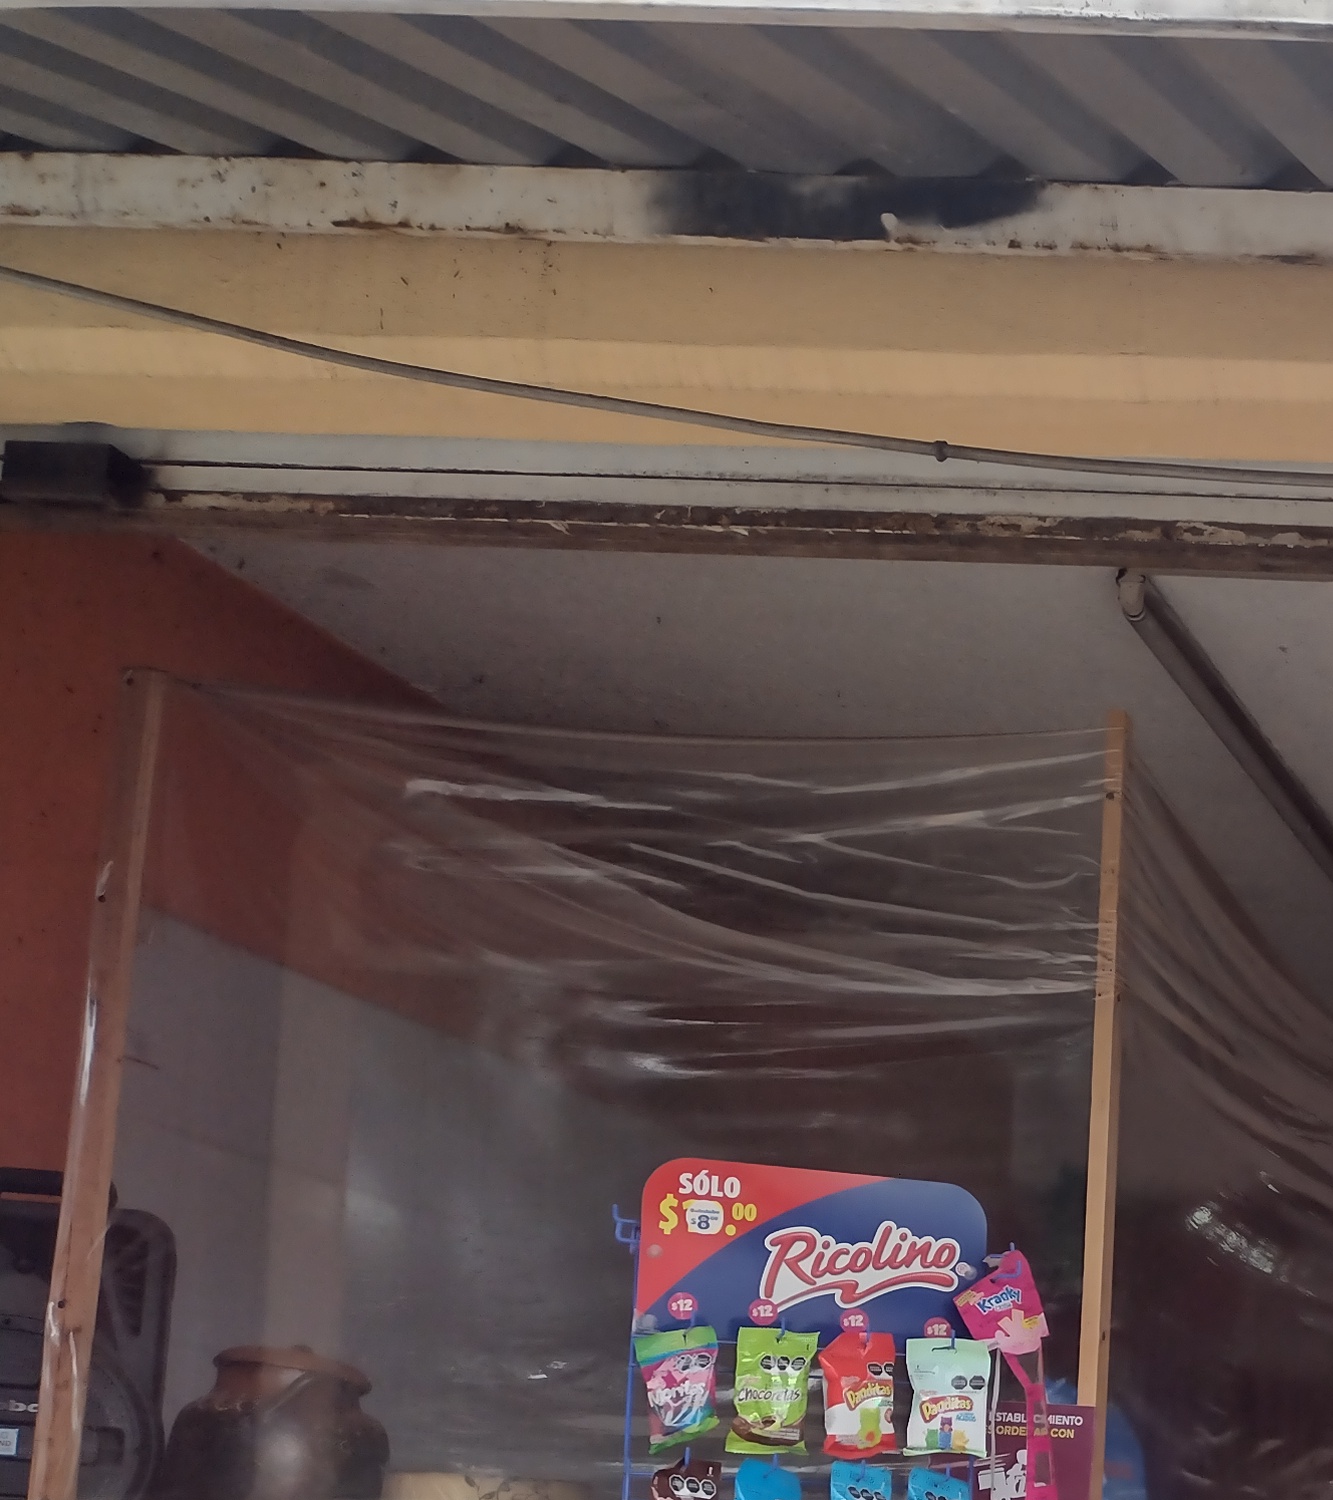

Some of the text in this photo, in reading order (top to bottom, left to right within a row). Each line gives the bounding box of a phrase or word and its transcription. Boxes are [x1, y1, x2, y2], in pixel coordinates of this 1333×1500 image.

[678, 1170, 741, 1198] SÓLO
[764, 1224, 958, 1300] Ricolino
[671, 1298, 693, 1311] $12
[976, 1286, 1022, 1313] Kranky
[752, 1304, 774, 1318] $12
[843, 1314, 865, 1328] $12
[926, 1323, 948, 1336] $12
[848, 1382, 892, 1409] Panditas
[921, 1396, 972, 1419] Panditas
[996, 1425, 1049, 1437] ORDEAR
[1050, 1426, 1075, 1439] CON
